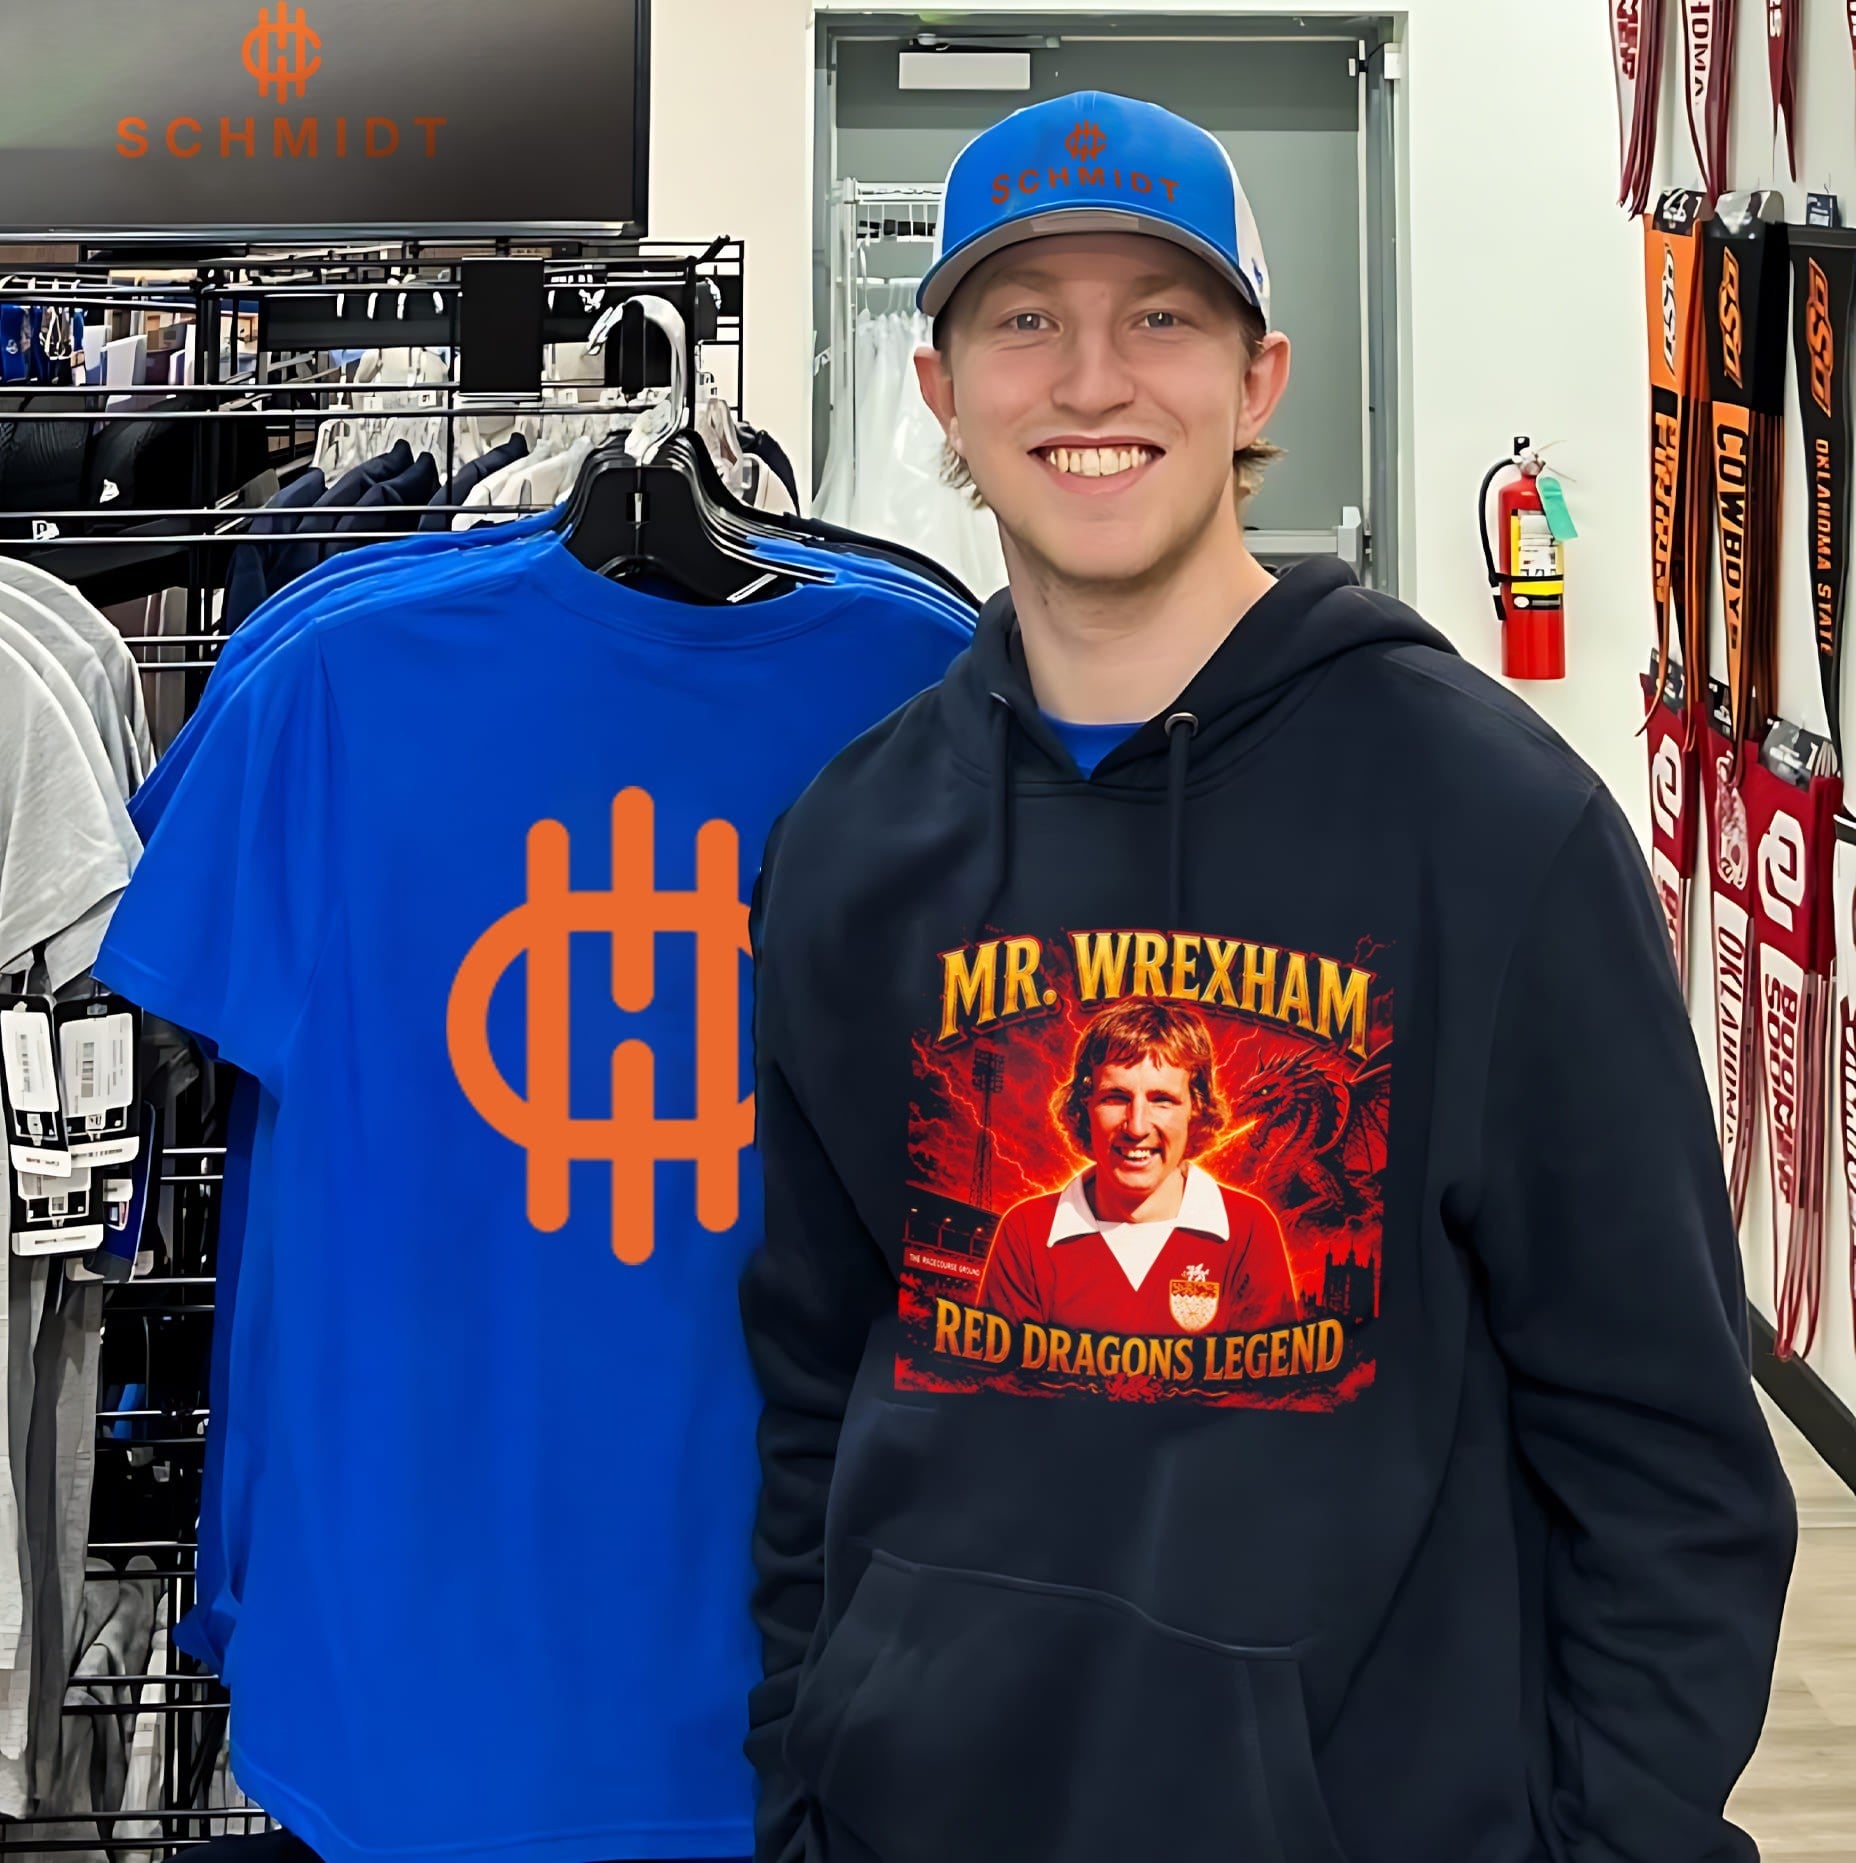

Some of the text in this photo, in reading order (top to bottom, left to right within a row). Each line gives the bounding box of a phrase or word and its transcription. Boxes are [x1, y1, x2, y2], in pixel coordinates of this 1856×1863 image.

[115, 116, 448, 158] SCHMIDT
[991, 167, 1179, 205] SCHMIDT
[1815, 438, 1833, 571] OKLAHOMA
[936, 930, 1375, 1059] MR. WREXHAM
[909, 1253, 920, 1263] THE
[922, 1256, 957, 1272] RACECOURSE
[935, 1298, 1345, 1381] RED DRAGONS LEGEND
